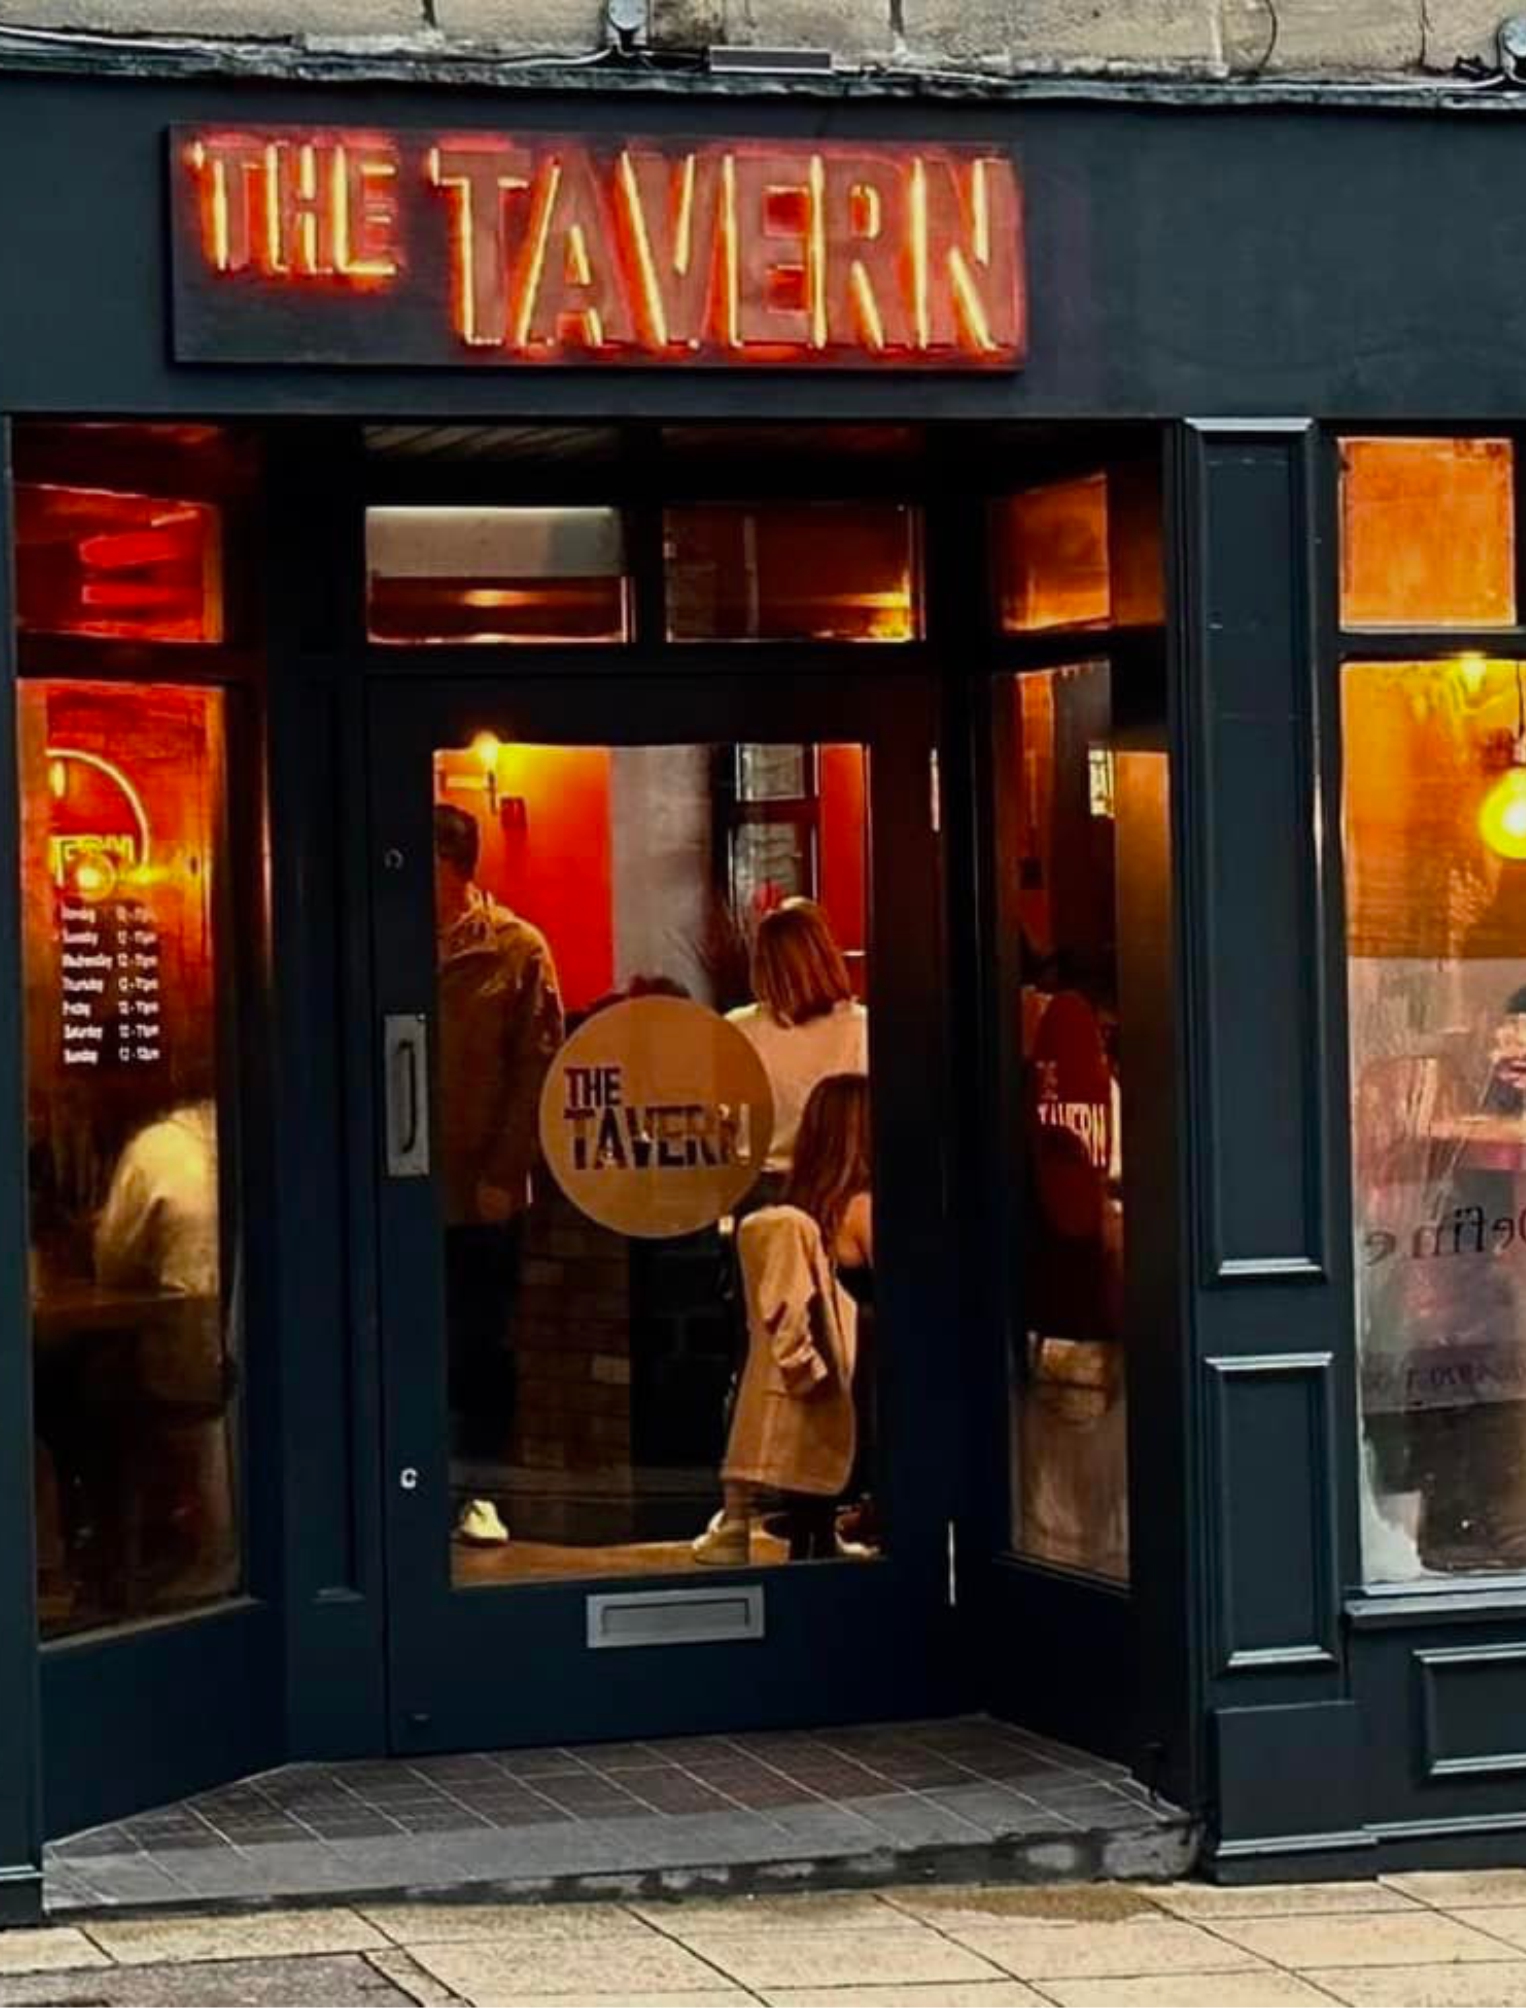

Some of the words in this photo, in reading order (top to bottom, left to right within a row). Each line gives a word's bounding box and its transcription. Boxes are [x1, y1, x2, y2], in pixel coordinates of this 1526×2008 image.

[190, 136, 398, 276] THE
[428, 138, 1024, 352] TAVERN
[563, 1066, 621, 1107] THE
[563, 1103, 752, 1170] TAVERN
